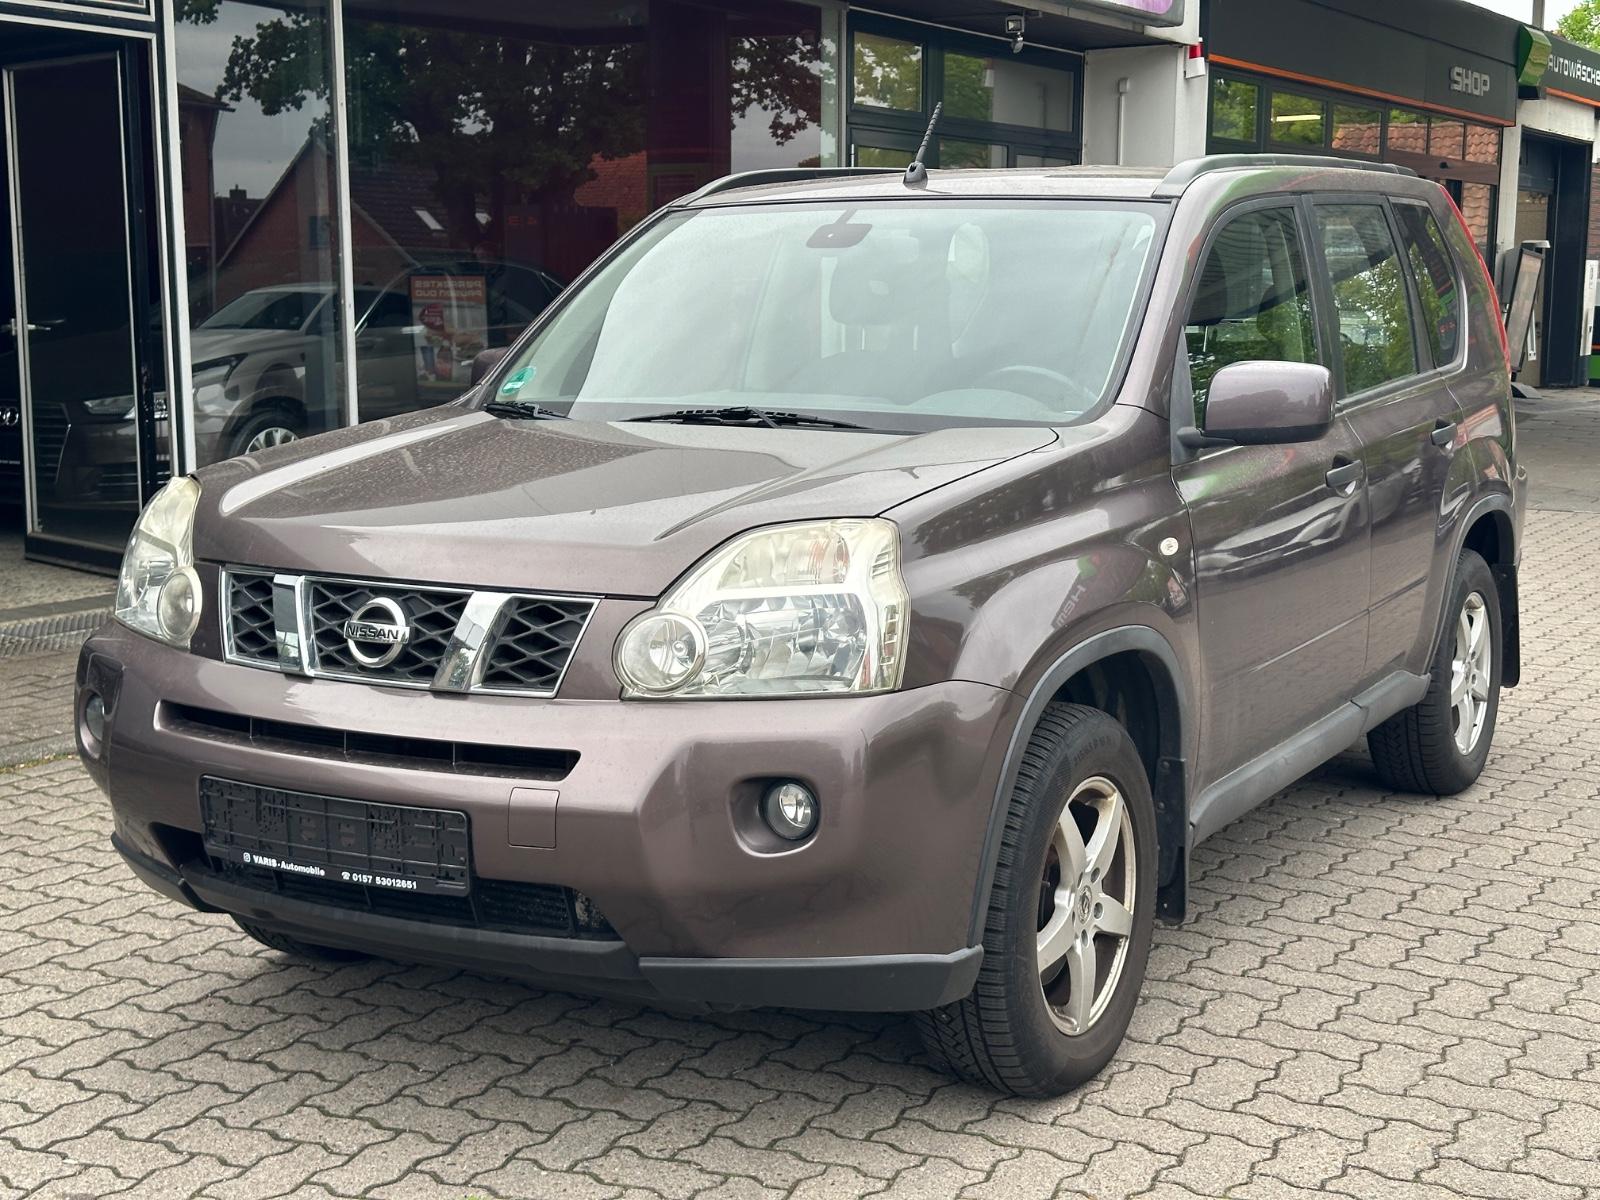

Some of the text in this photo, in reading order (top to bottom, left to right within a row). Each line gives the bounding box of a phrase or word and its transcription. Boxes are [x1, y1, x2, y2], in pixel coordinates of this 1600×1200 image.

[1451, 66, 1490, 96] SHOP
[347, 625, 399, 640] NISSAN
[352, 873, 372, 883] 0157
